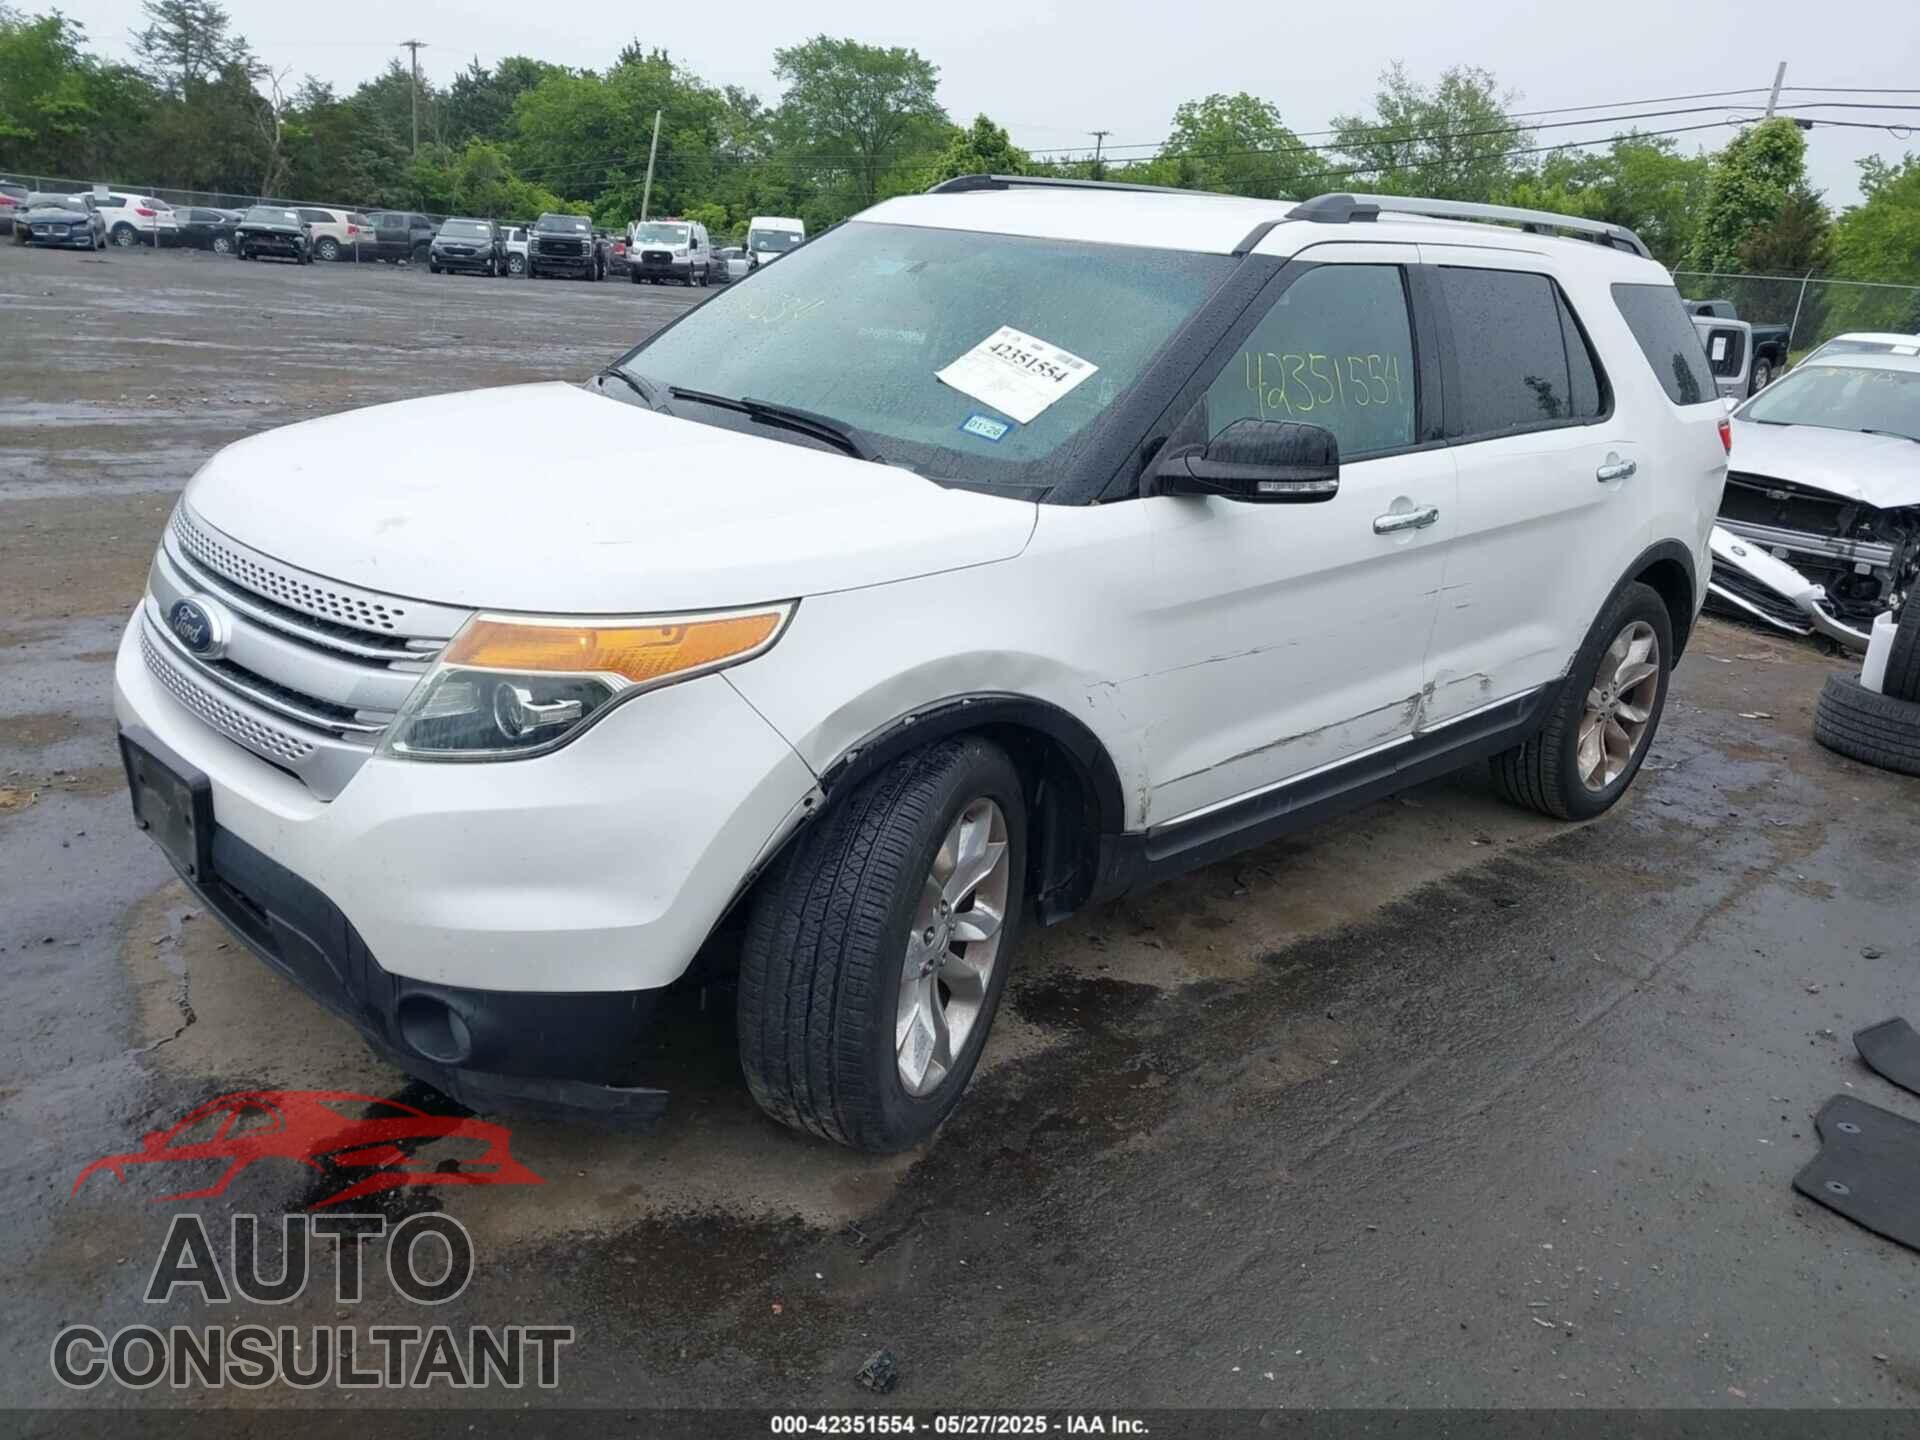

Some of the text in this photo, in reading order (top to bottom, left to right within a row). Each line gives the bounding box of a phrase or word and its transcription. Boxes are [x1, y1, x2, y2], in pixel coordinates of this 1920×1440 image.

[988, 341, 1069, 383] 42351554
[1244, 352, 1401, 418] 42351554
[174, 606, 203, 643] Ford
